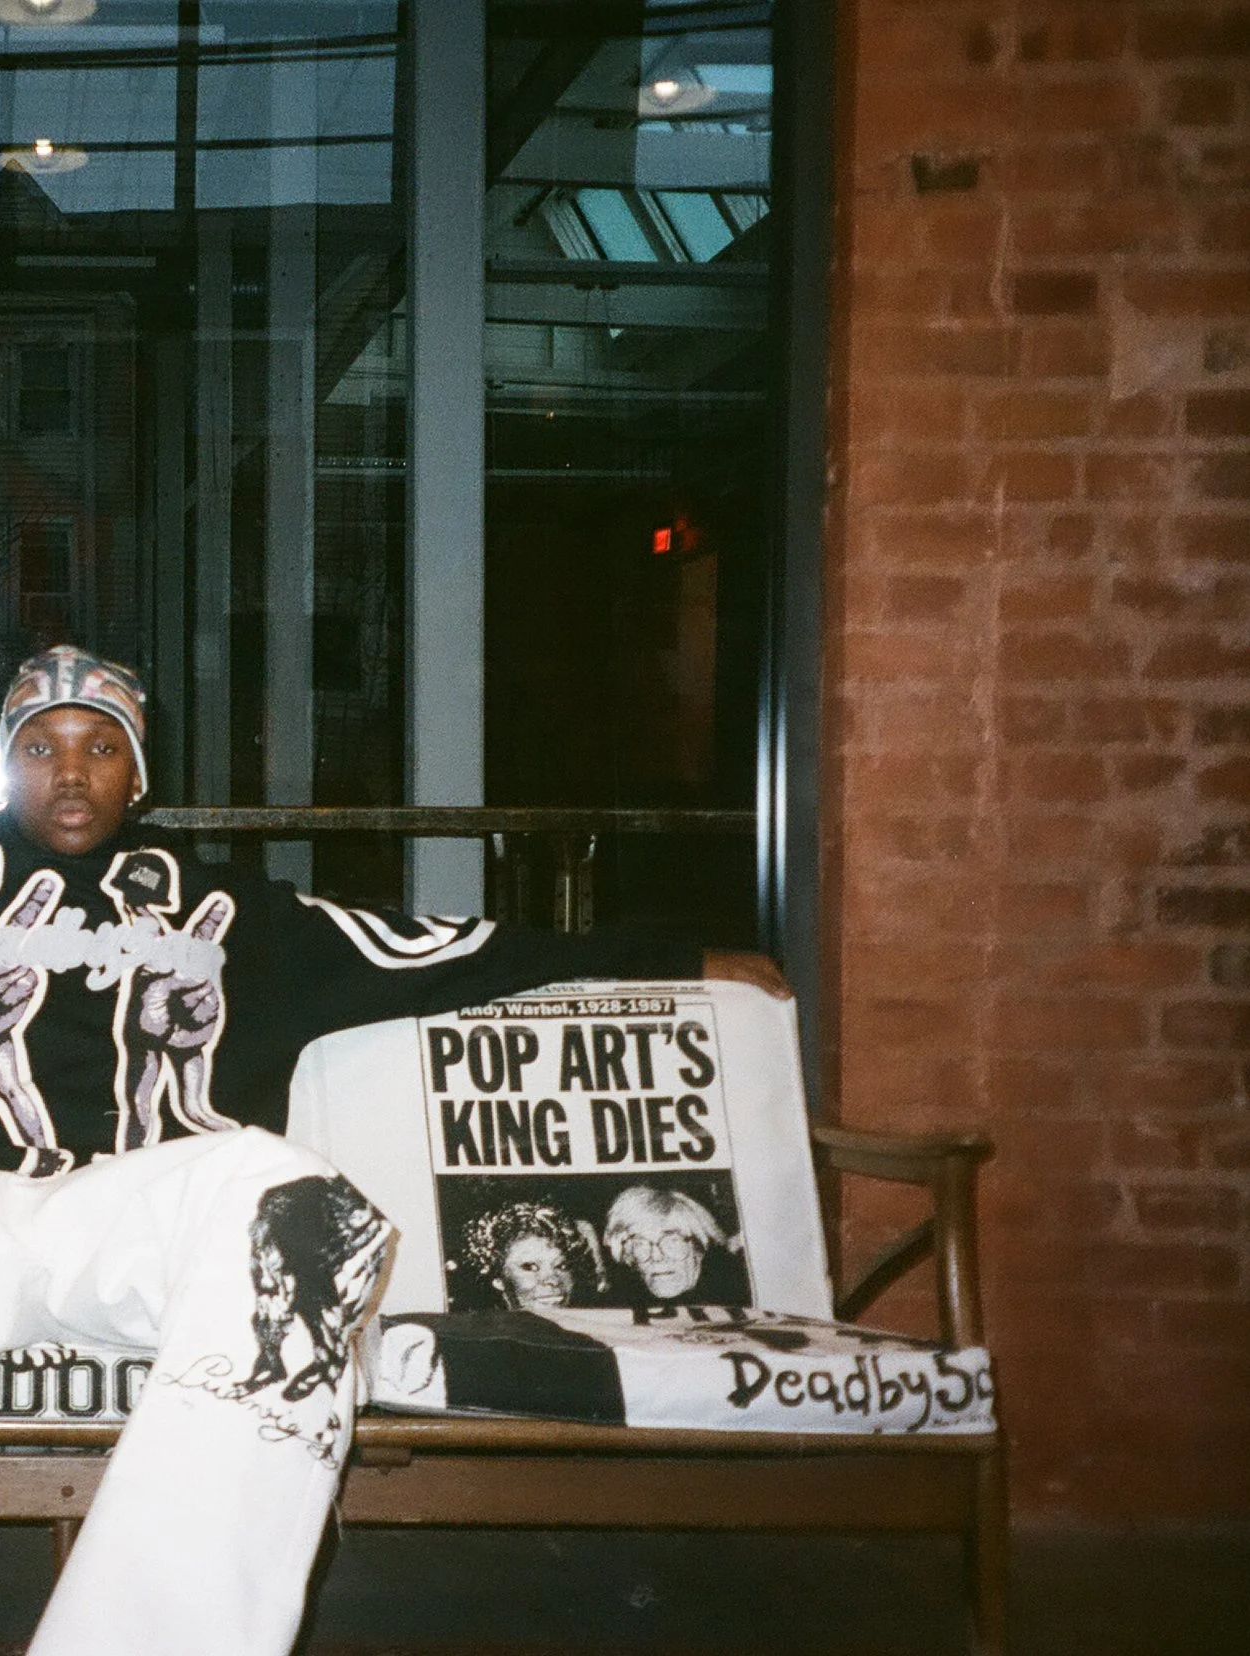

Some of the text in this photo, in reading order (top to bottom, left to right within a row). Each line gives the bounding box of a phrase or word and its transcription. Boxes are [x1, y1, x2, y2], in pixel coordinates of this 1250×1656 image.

[459, 999, 672, 1018] Andy Warhol, 1928-1987
[427, 1021, 716, 1094] POP ART'S
[440, 1094, 717, 1167] KING DIES
